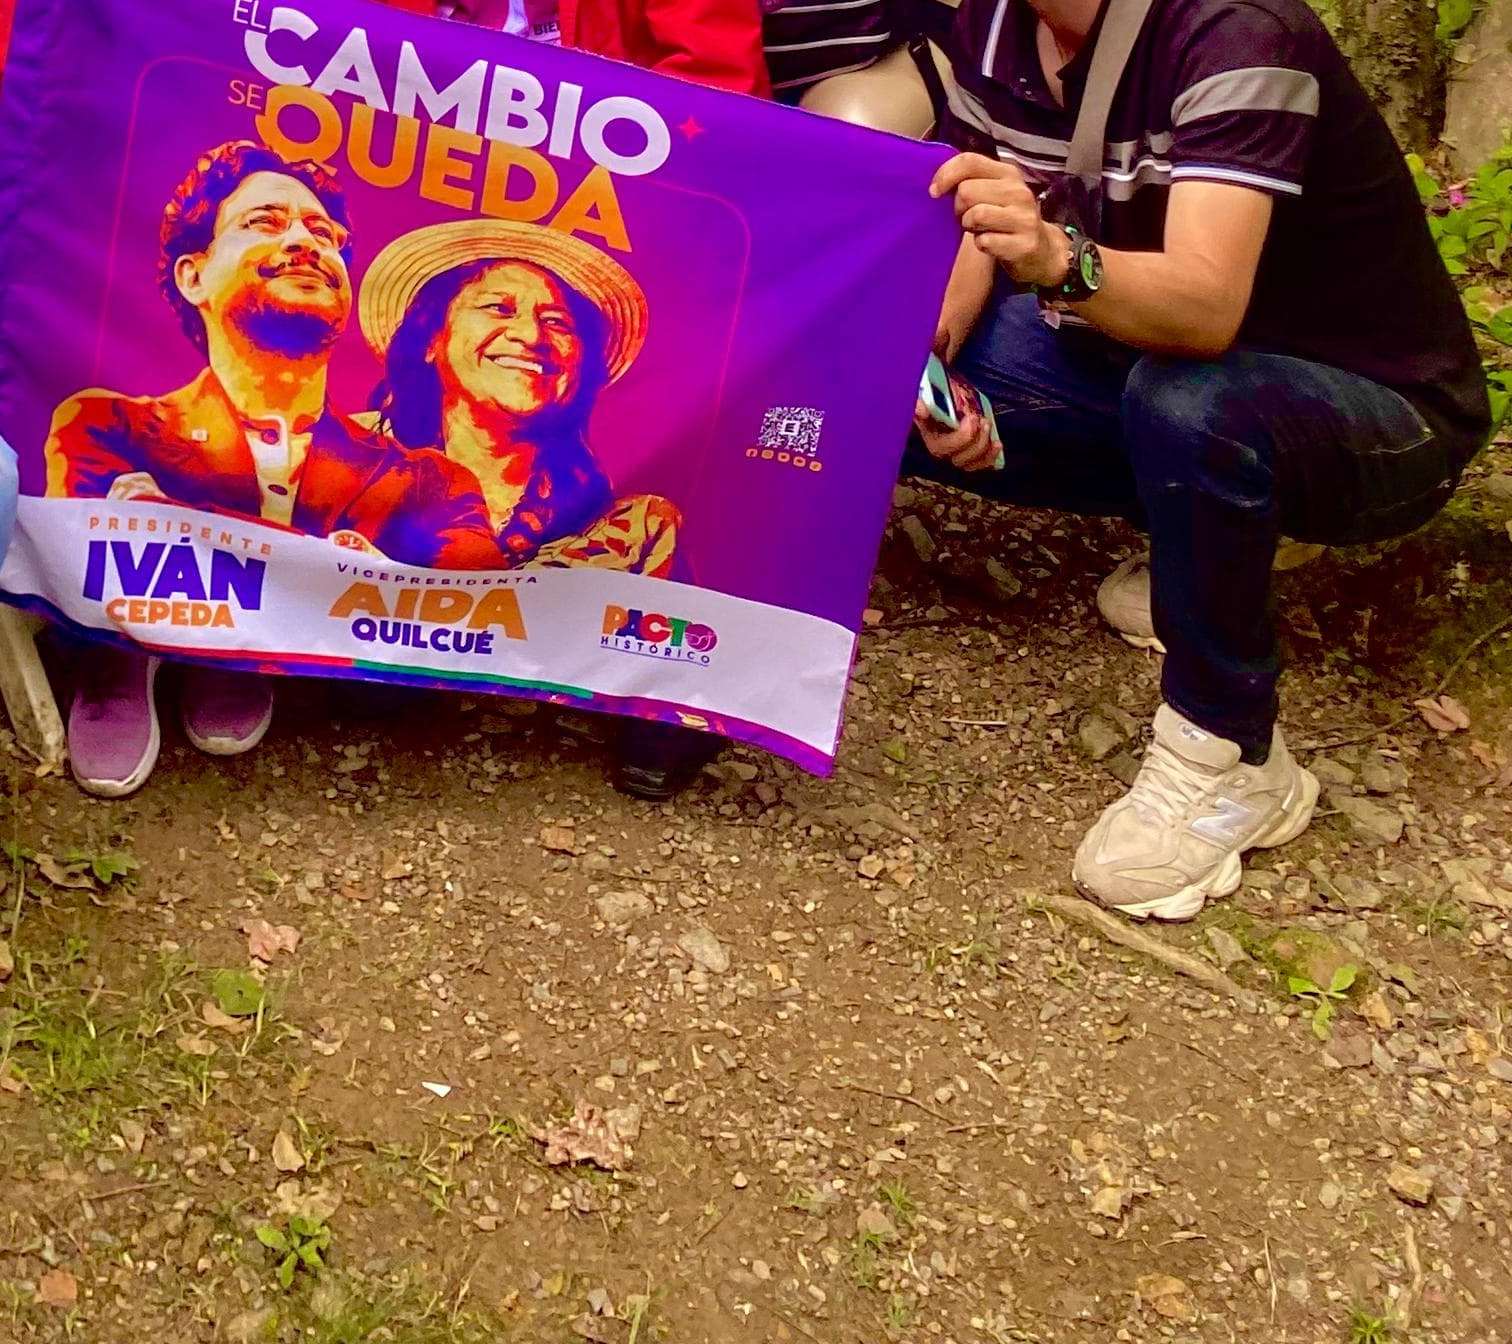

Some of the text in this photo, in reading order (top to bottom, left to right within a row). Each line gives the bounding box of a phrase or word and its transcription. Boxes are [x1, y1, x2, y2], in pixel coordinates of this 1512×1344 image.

[244, 6, 671, 176] CAMBIO
[227, 79, 633, 253] SE QUEDA
[89, 516, 272, 556] PRESIDENTE
[82, 536, 266, 611] IVÁN
[337, 562, 537, 586] VICEPRESIDENTA
[105, 597, 235, 628] CEPEDA
[328, 581, 528, 641] AIDA
[602, 604, 717, 653] PACTO
[351, 617, 494, 655] QUILCUÉ
[600, 635, 710, 664] HISTÓRICO
